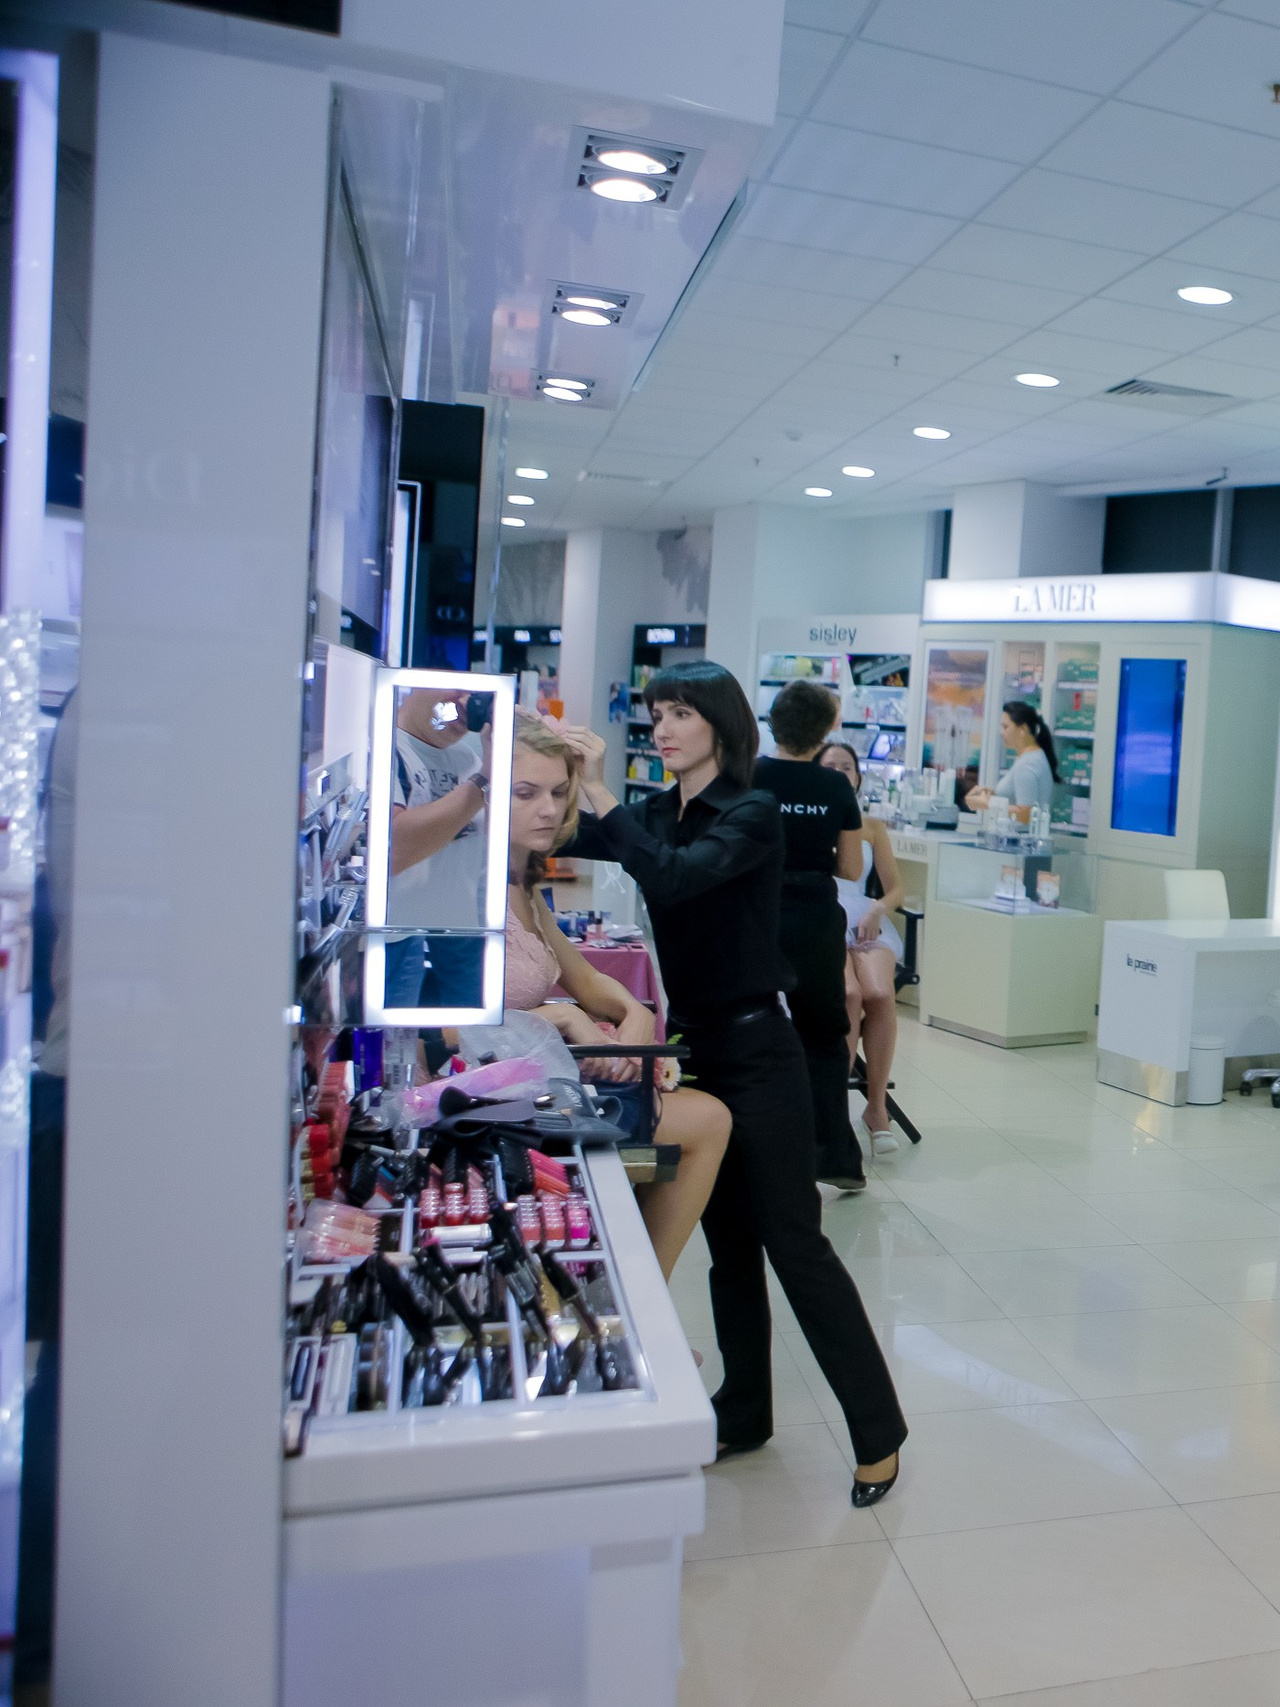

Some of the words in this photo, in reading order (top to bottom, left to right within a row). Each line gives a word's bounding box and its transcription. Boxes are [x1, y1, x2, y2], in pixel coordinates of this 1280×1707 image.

[1014, 585, 1042, 613] LA
[1050, 583, 1097, 613] MER
[809, 623, 857, 646] sisley
[780, 802, 829, 816] NCHY
[910, 842, 929, 857] MER
